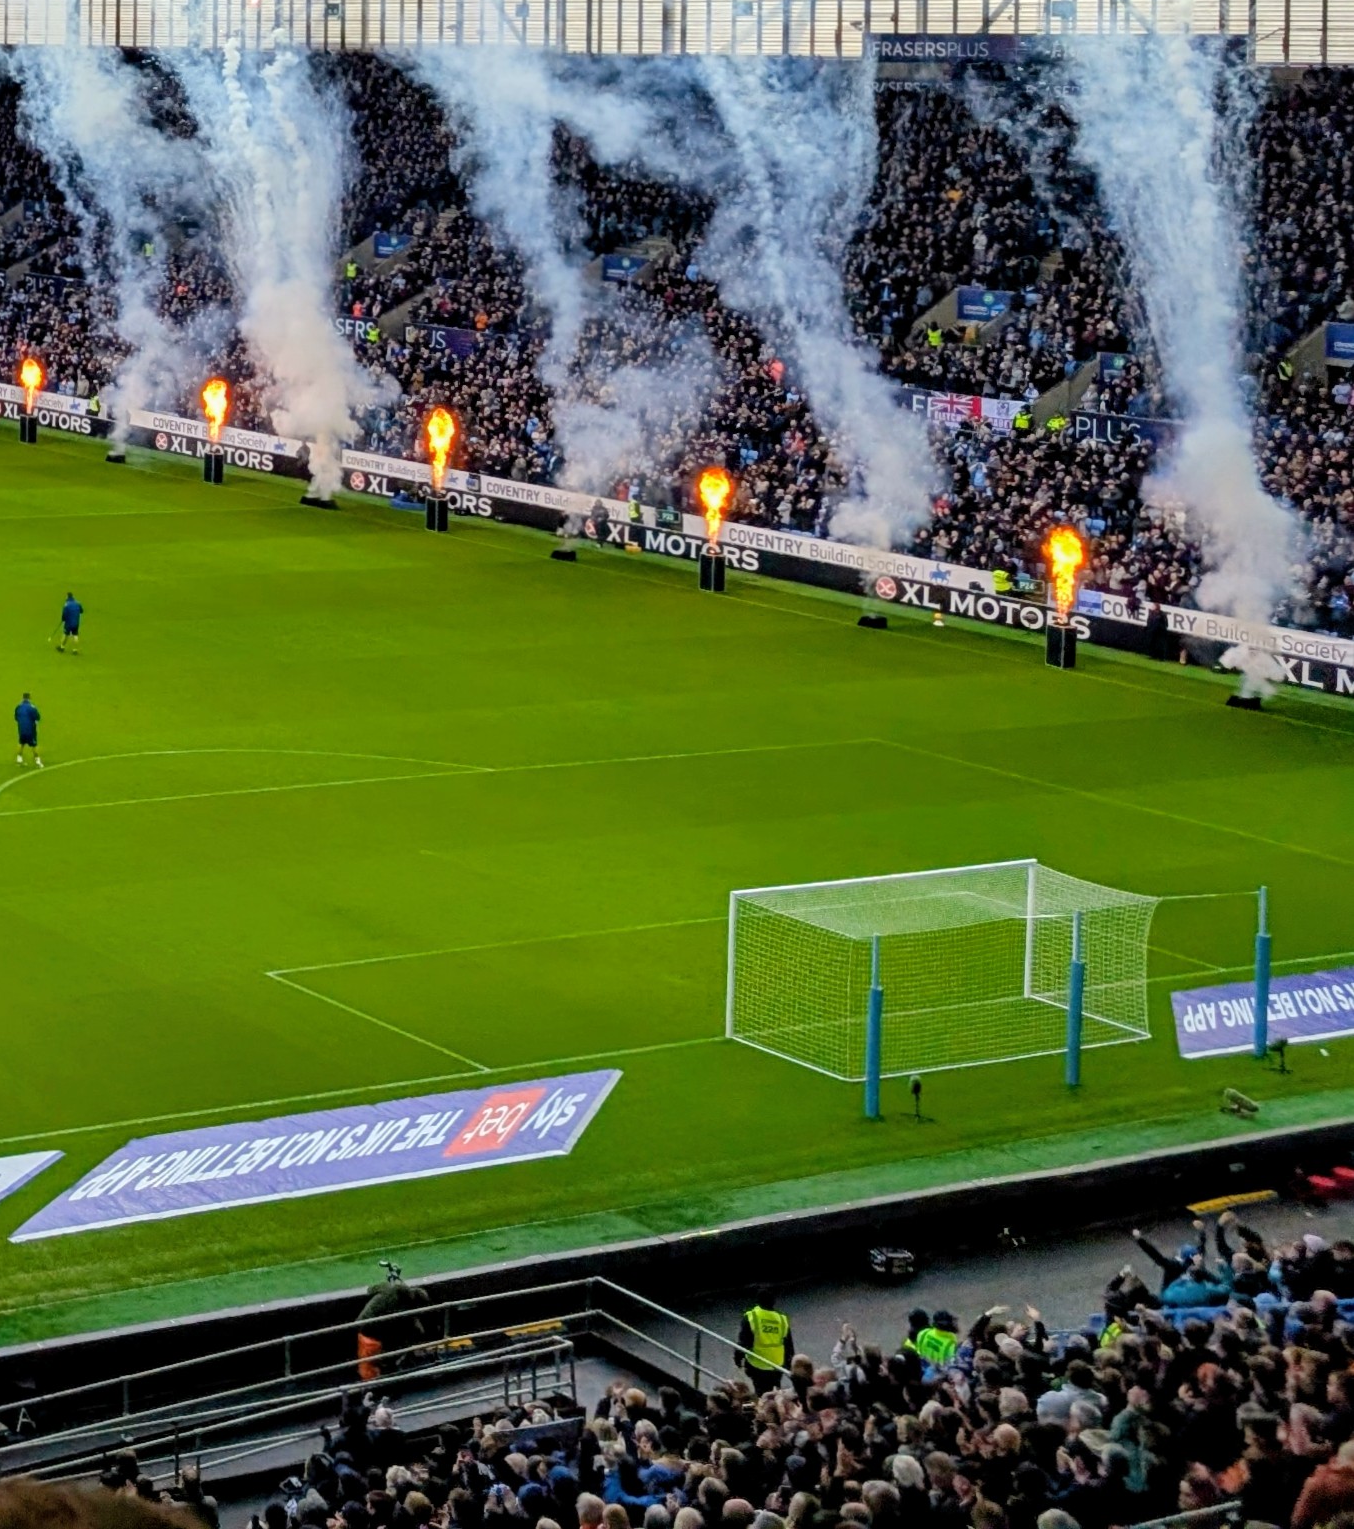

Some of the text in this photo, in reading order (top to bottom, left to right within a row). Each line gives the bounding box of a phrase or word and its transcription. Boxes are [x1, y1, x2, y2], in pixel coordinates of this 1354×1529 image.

[872, 41, 989, 57] FRASERSPLUS
[4, 402, 91, 434] XL OTORS
[153, 416, 199, 435] COVENTRY
[237, 433, 267, 450] Society
[171, 435, 193, 455] XL
[346, 455, 386, 471] COVENTRY
[367, 474, 394, 497] XL
[486, 482, 543, 503] COVENTRY
[607, 523, 638, 546] XL
[729, 527, 917, 578] COVENTRY Building Society
[900, 582, 941, 609] XL
[1101, 599, 1198, 632] COVETRY
[1282, 635, 1347, 664] Society
[1274, 655, 1324, 689] XL
[1183, 1002, 1217, 1033] APP
[1218, 991, 1298, 1028] BEING
[390, 1109, 464, 1152] THE
[463, 1102, 530, 1145] bet
[520, 1088, 587, 1139] sky
[68, 1153, 167, 1202] APP
[135, 1136, 287, 1191] BETTING
